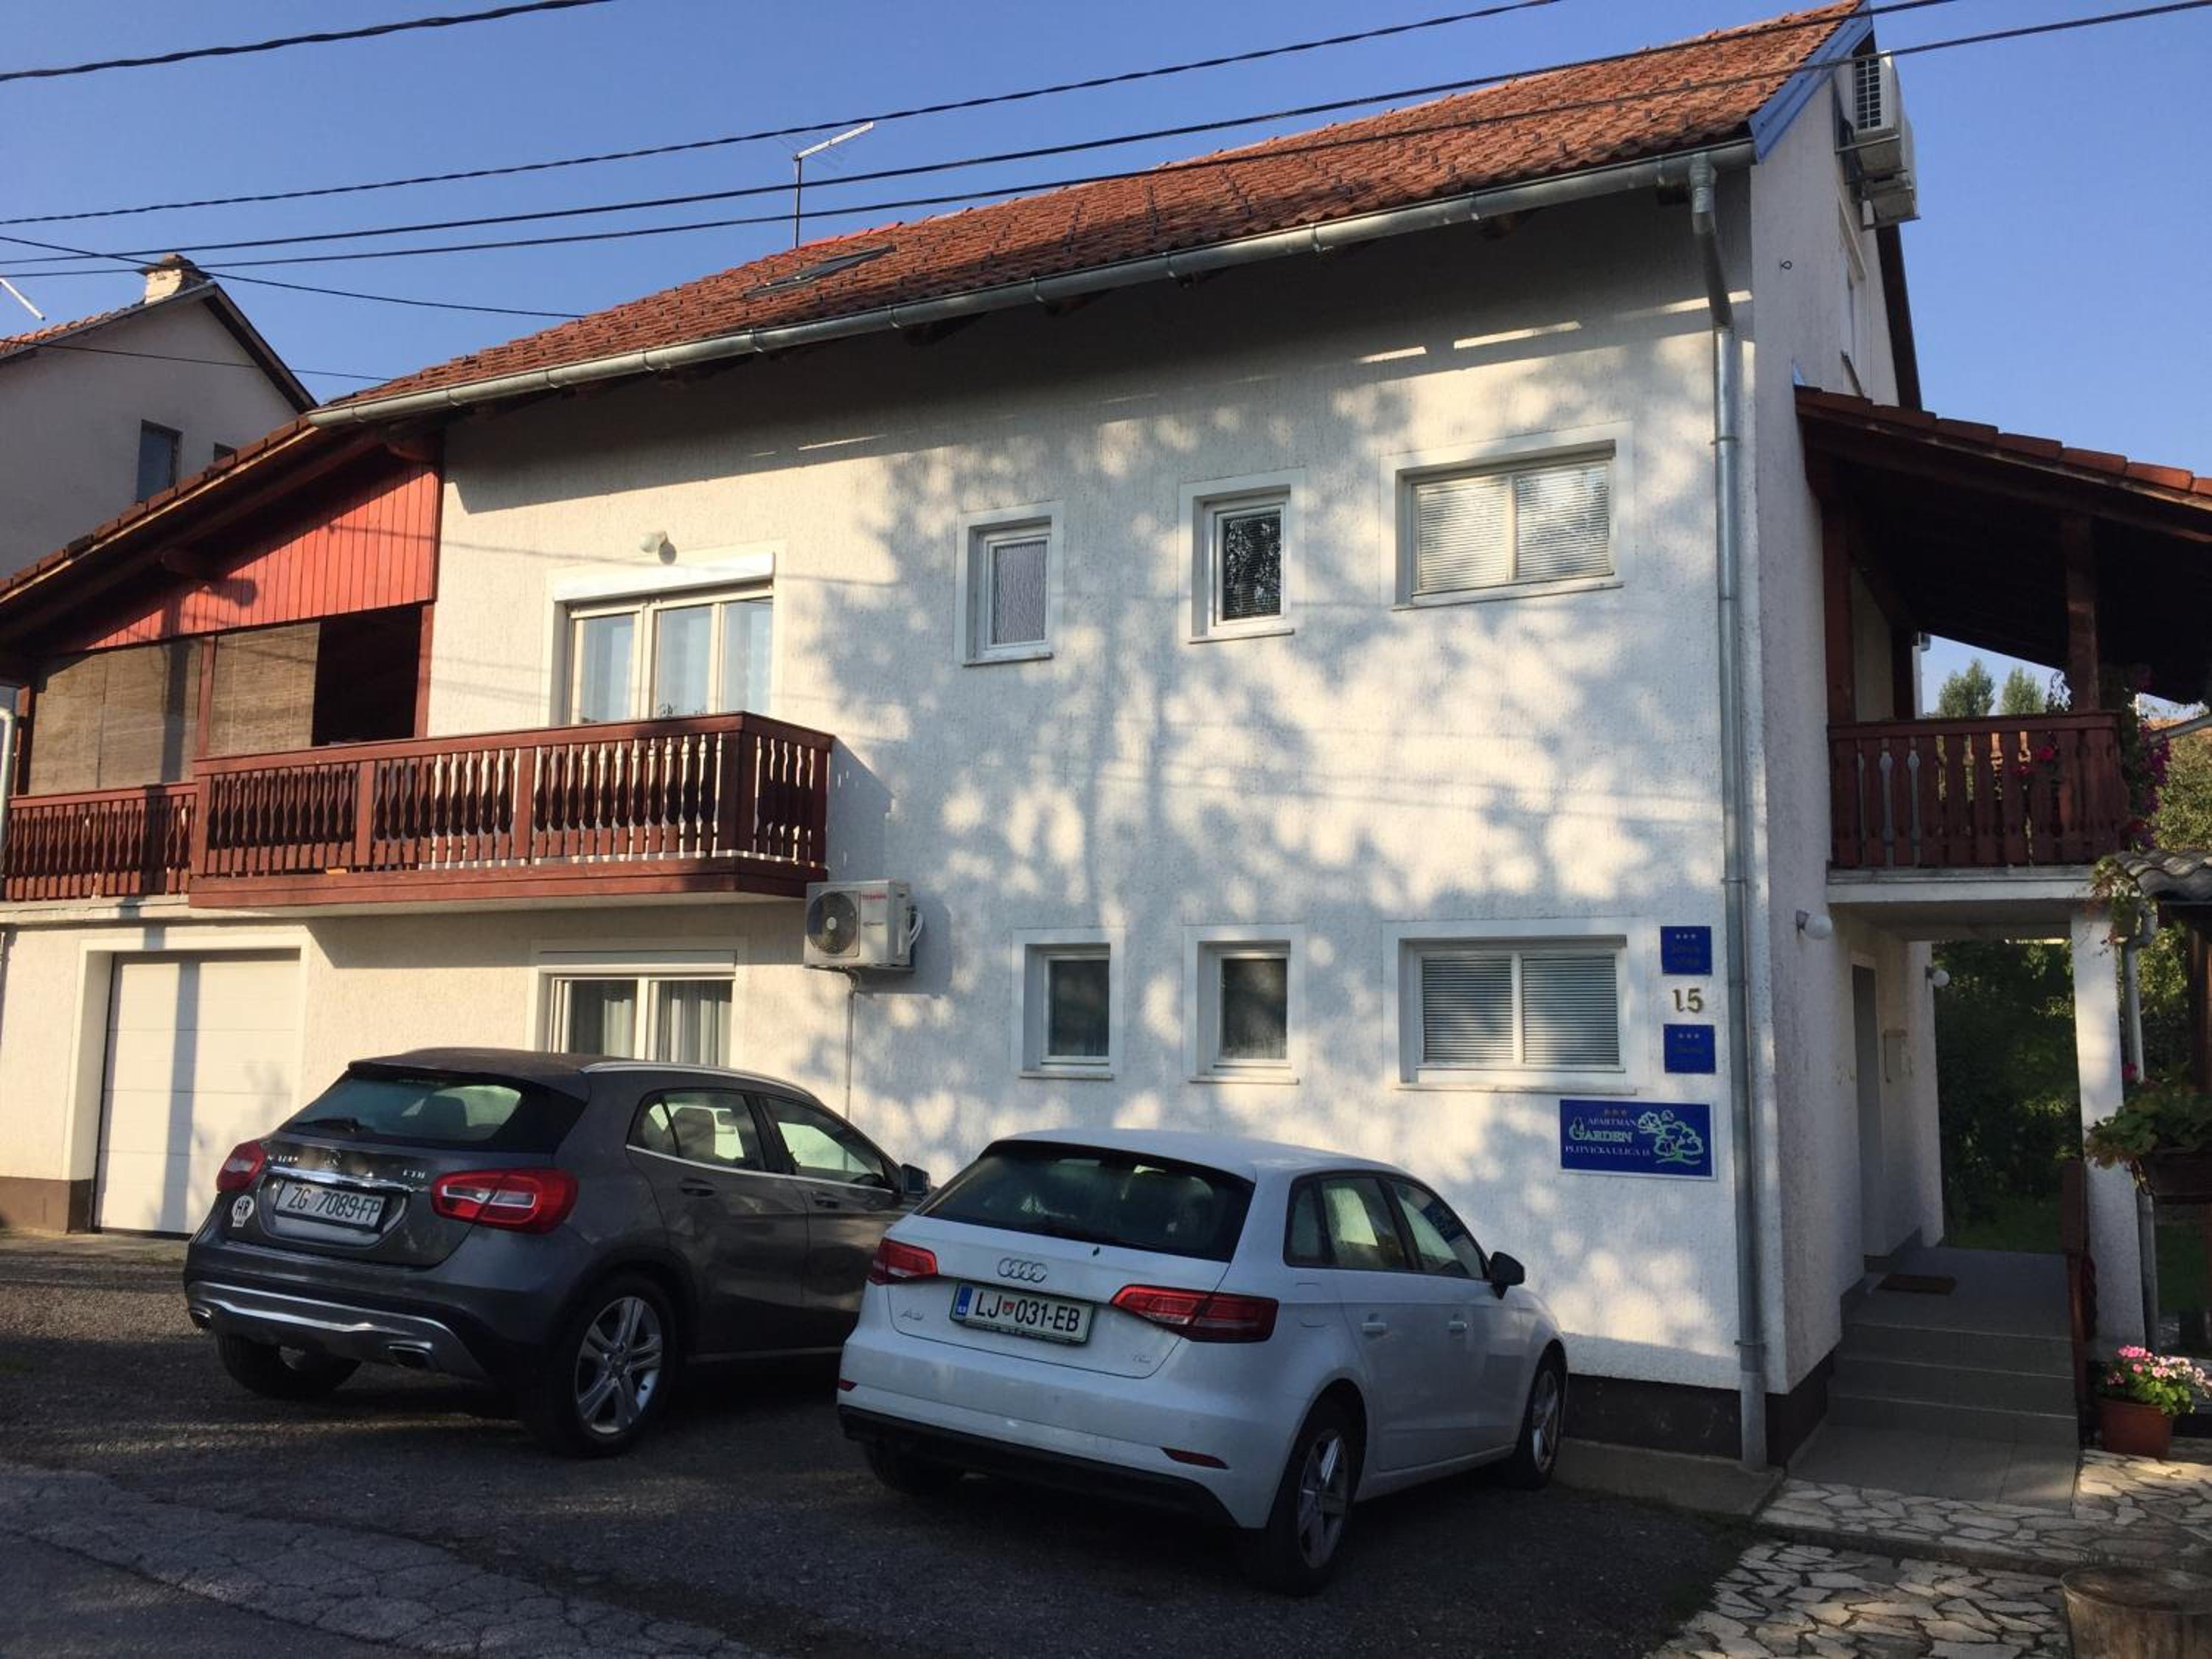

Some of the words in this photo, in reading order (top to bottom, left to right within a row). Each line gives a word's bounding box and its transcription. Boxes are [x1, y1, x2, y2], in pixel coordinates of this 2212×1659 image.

[1672, 988, 1704, 1014] 15
[1568, 1116, 1633, 1144] GARDEN
[1587, 1117, 1637, 1127] APARTMAN
[287, 1186, 311, 1210] ZG
[316, 1191, 381, 1222] 7089-FP
[975, 1291, 1003, 1319] LJ
[1014, 1301, 1080, 1333] 031-EB
